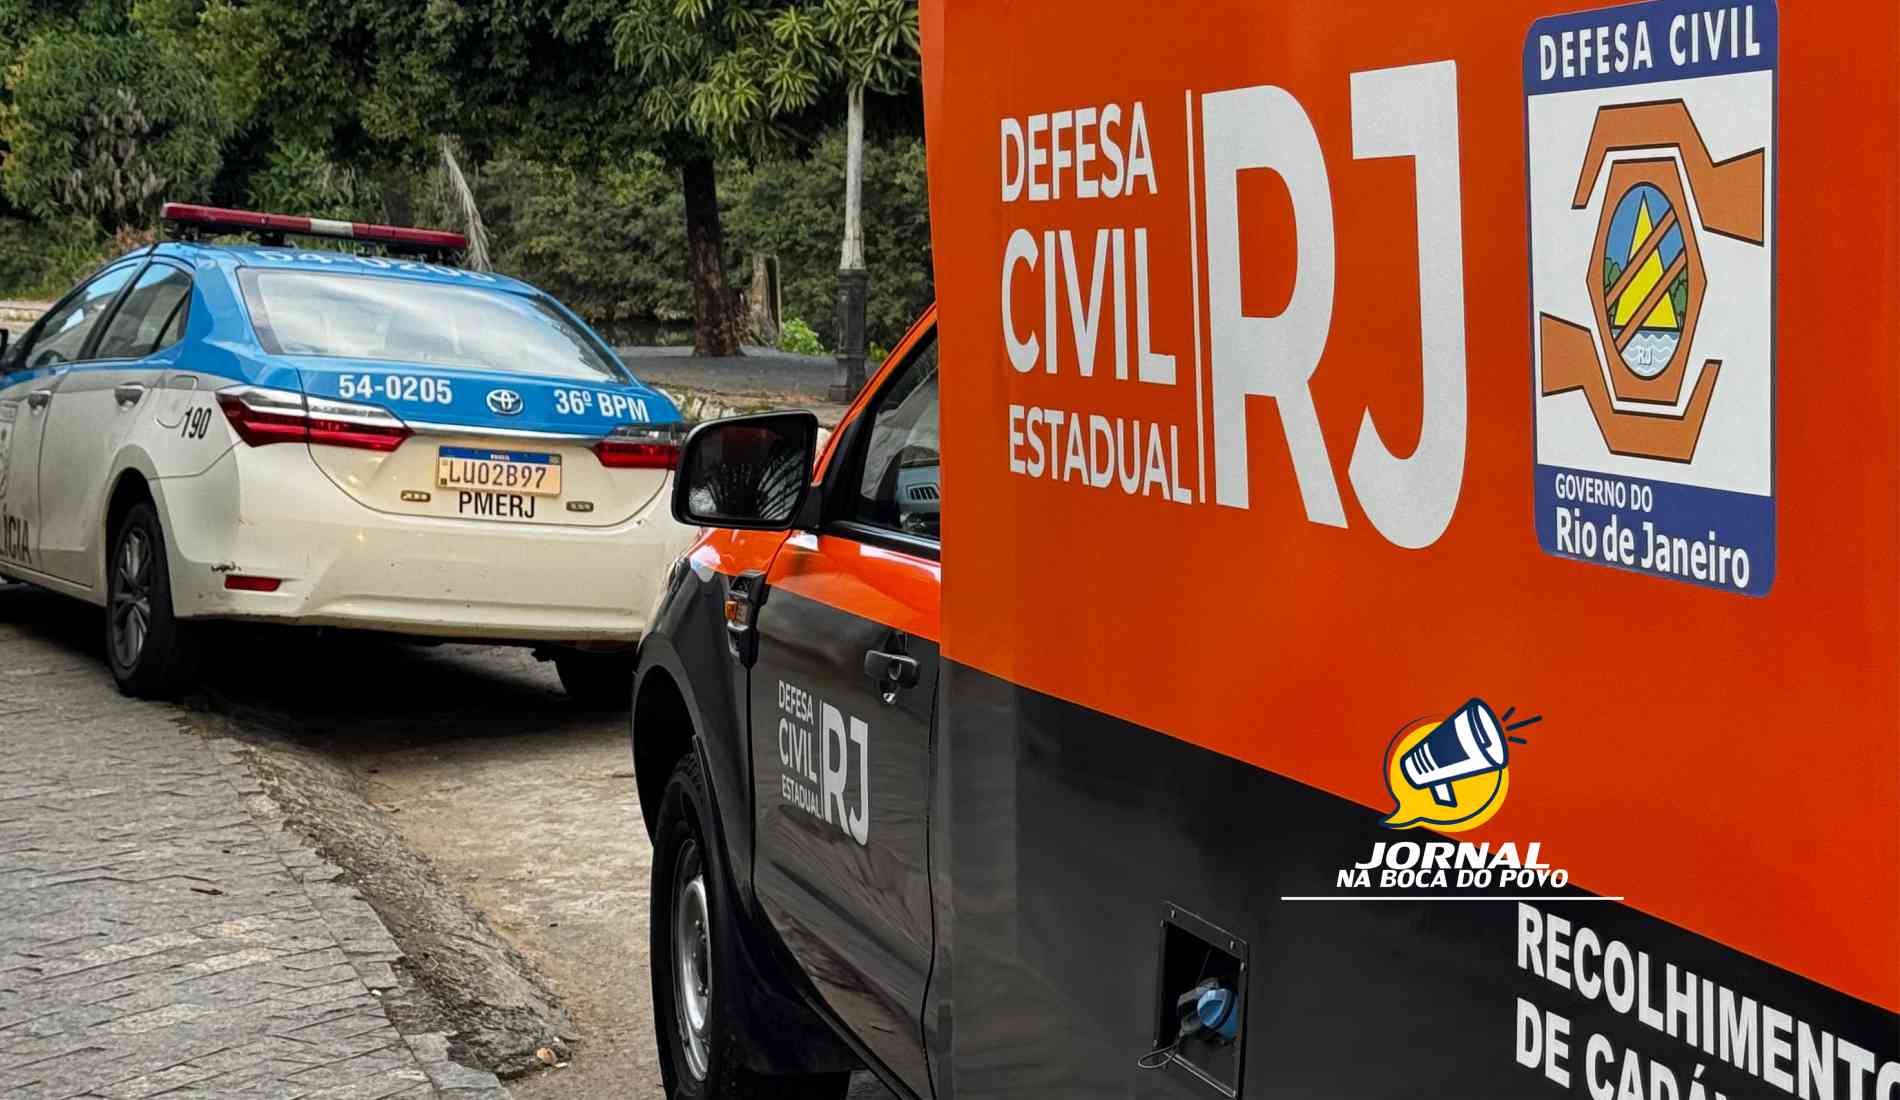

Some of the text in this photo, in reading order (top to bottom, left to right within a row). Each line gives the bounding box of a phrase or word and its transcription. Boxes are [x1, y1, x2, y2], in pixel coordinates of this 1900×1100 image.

[1539, 5, 1761, 81] DEFESA CIVIL
[1001, 101, 1159, 202] DEFESA
[1001, 228, 1177, 386] CIVIL
[1202, 59, 1468, 550] RJ
[181, 406, 212, 440] 190
[338, 374, 453, 404] 54-0205
[597, 391, 650, 423] BPM
[1008, 404, 1193, 505] ESTADUAL
[1555, 472, 1653, 513] GOVERNO DO
[458, 491, 536, 519] PMERJ
[1556, 506, 1750, 589] Rio de Janeiro
[778, 679, 815, 726] DEFESA
[778, 717, 818, 784] CIVIL
[822, 701, 870, 846] RJ
[781, 773, 824, 819] ESTADUAL
[1517, 901, 1900, 1100] RECOLHIMENT
[1516, 997, 1570, 1090] DE
